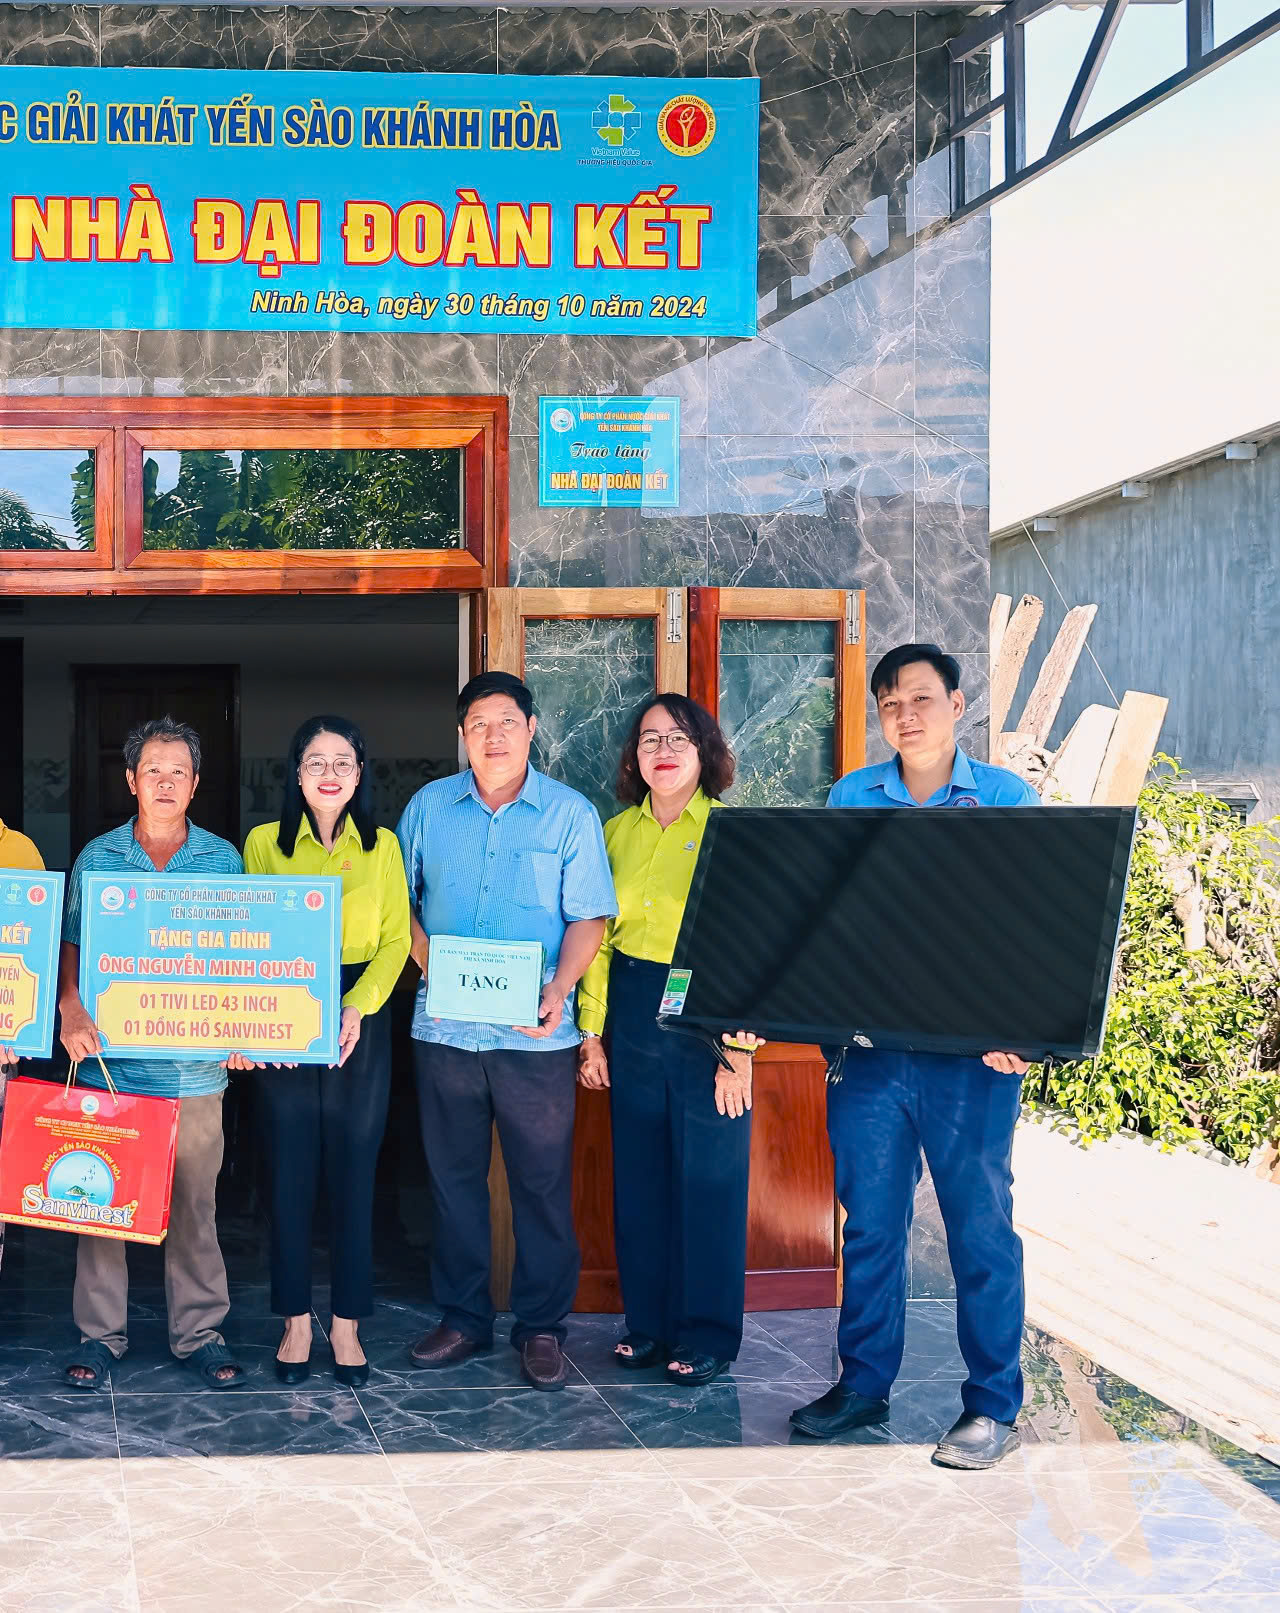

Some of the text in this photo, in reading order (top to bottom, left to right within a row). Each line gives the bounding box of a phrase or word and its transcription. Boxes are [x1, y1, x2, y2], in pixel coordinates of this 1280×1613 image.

[26, 90, 98, 144] GIẢI
[106, 96, 198, 145] KHÁT
[204, 93, 274, 146] YẾN
[282, 99, 354, 148] SÀO
[362, 101, 482, 149] KHÁNH
[490, 101, 561, 150] HÒA
[11, 184, 174, 263] NHÀ
[192, 196, 321, 278] ĐẠI
[340, 188, 553, 270] ĐOÀN
[573, 184, 713, 271] KẾT
[250, 290, 707, 321] Ninh Hòa, ngày 30 tháng 10 năm 2024
[551, 468, 668, 493] NHÀ ĐẠI ĐOÀN KẾT
[145, 887, 167, 902] CÔNG
[168, 888, 179, 901] TY
[0, 921, 32, 945] KẾT
[148, 925, 271, 950] TẶNG GIA ĐÌNH
[98, 953, 135, 974] ÔNG
[138, 953, 206, 976] NGUYỄN
[209, 959, 256, 977] MINH
[458, 972, 508, 992] TẶNG
[140, 993, 277, 1012] 01 TIVI LED 43 INCH
[124, 1016, 294, 1040] 01 ĐỒNG HỒ SANVINEST
[22, 1182, 135, 1228] Sanvinest
